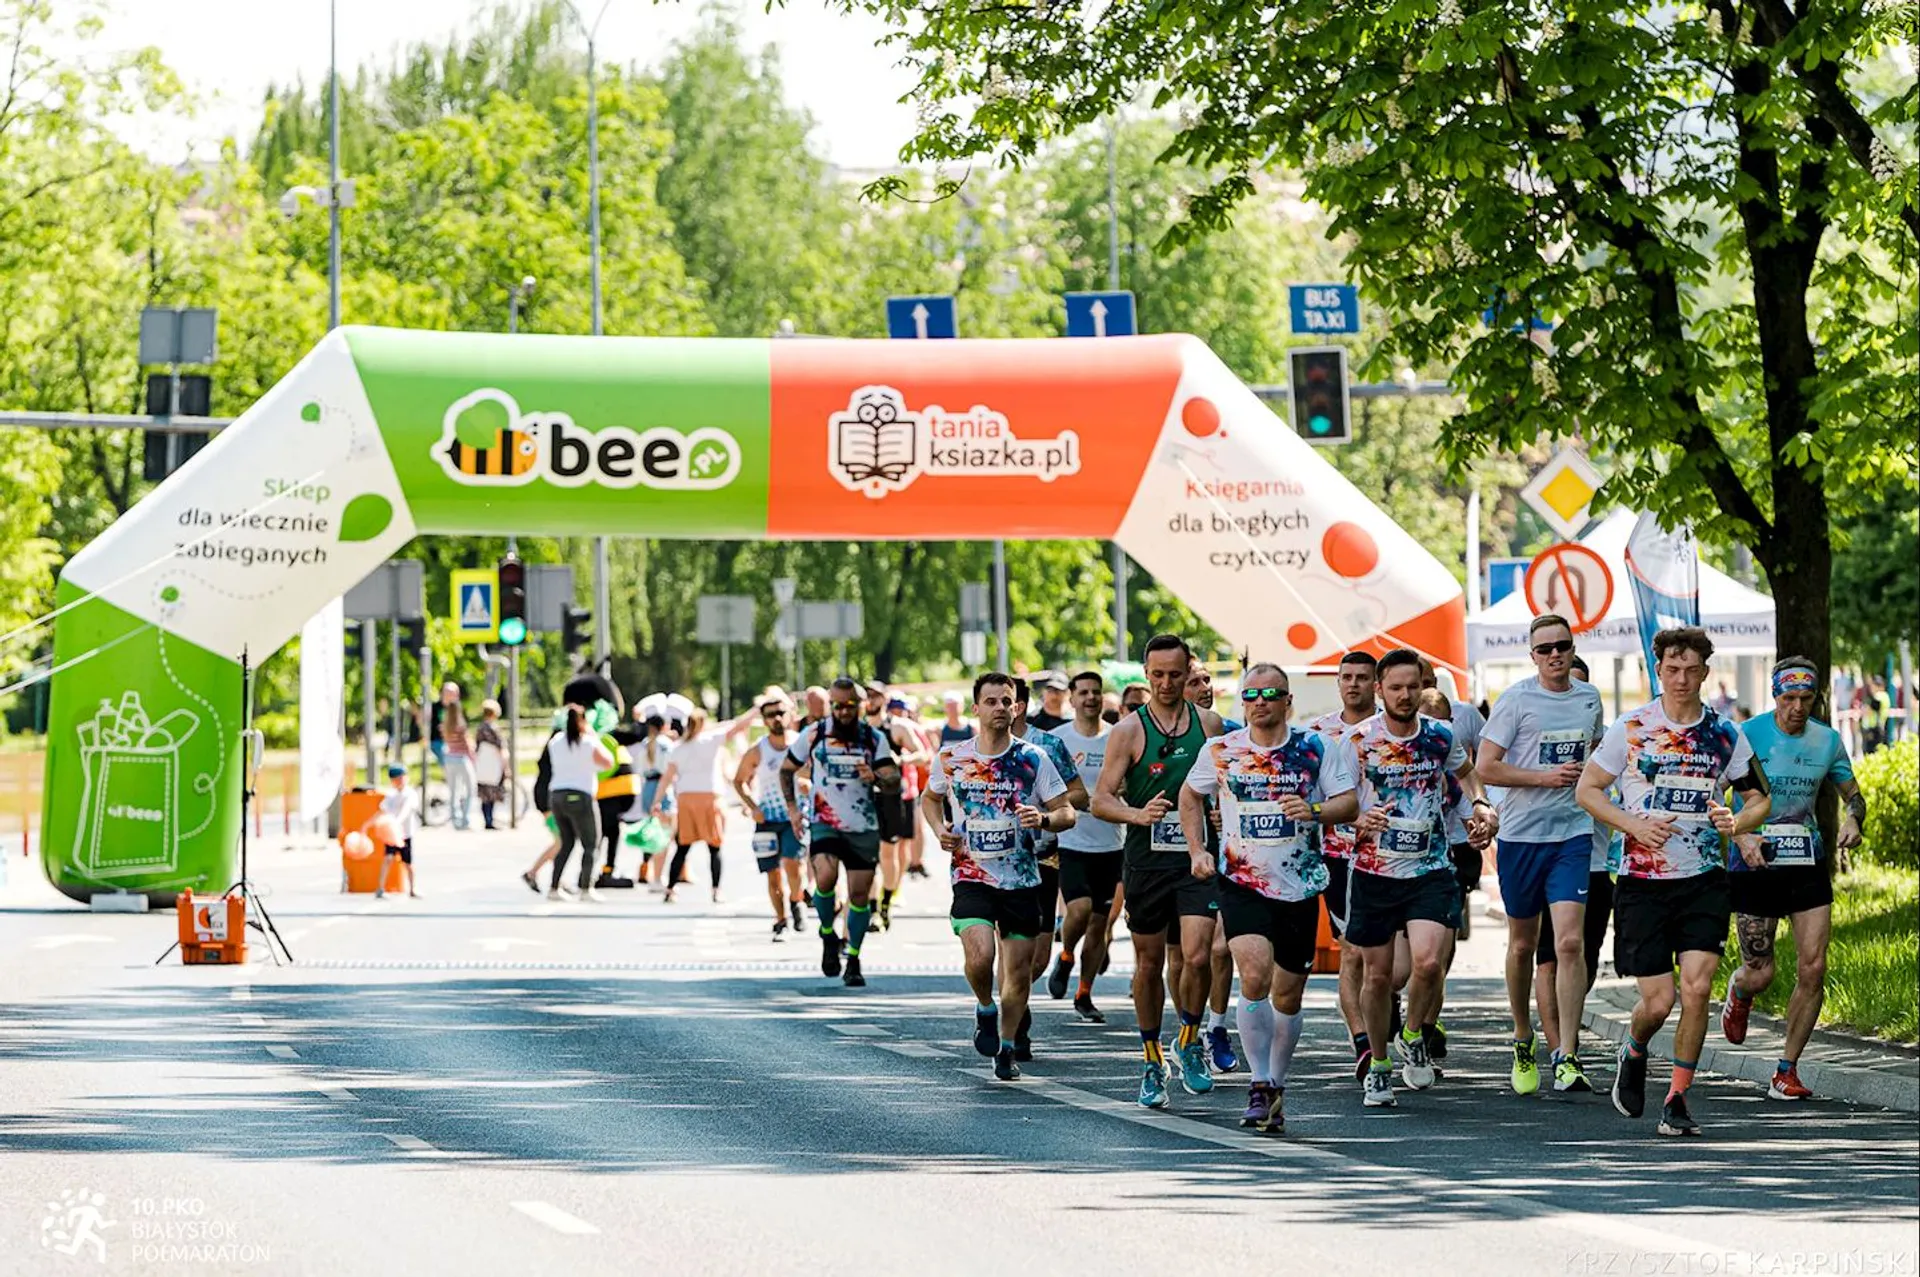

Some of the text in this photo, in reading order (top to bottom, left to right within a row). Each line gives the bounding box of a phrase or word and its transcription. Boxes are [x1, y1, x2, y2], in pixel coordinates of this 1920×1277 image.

[1304, 288, 1341, 308] BUS
[1303, 309, 1346, 329] TAXI
[930, 413, 1000, 438] tania
[550, 423, 680, 479] bee
[930, 440, 1072, 473] ksiazka.pl
[264, 478, 331, 504] Sklep
[1185, 477, 1305, 502] Księgarnia
[178, 508, 329, 532] dla wiecznie
[1169, 508, 1309, 537] dla biegłych
[174, 540, 327, 568] zabieganych
[1209, 548, 1311, 572] czytaczy
[1556, 743, 1576, 755] 697
[1672, 789, 1697, 803] 817
[1252, 814, 1283, 828] 1071
[980, 831, 1007, 843] 1464
[1396, 830, 1420, 844] 962
[1777, 837, 1805, 848] 2468
